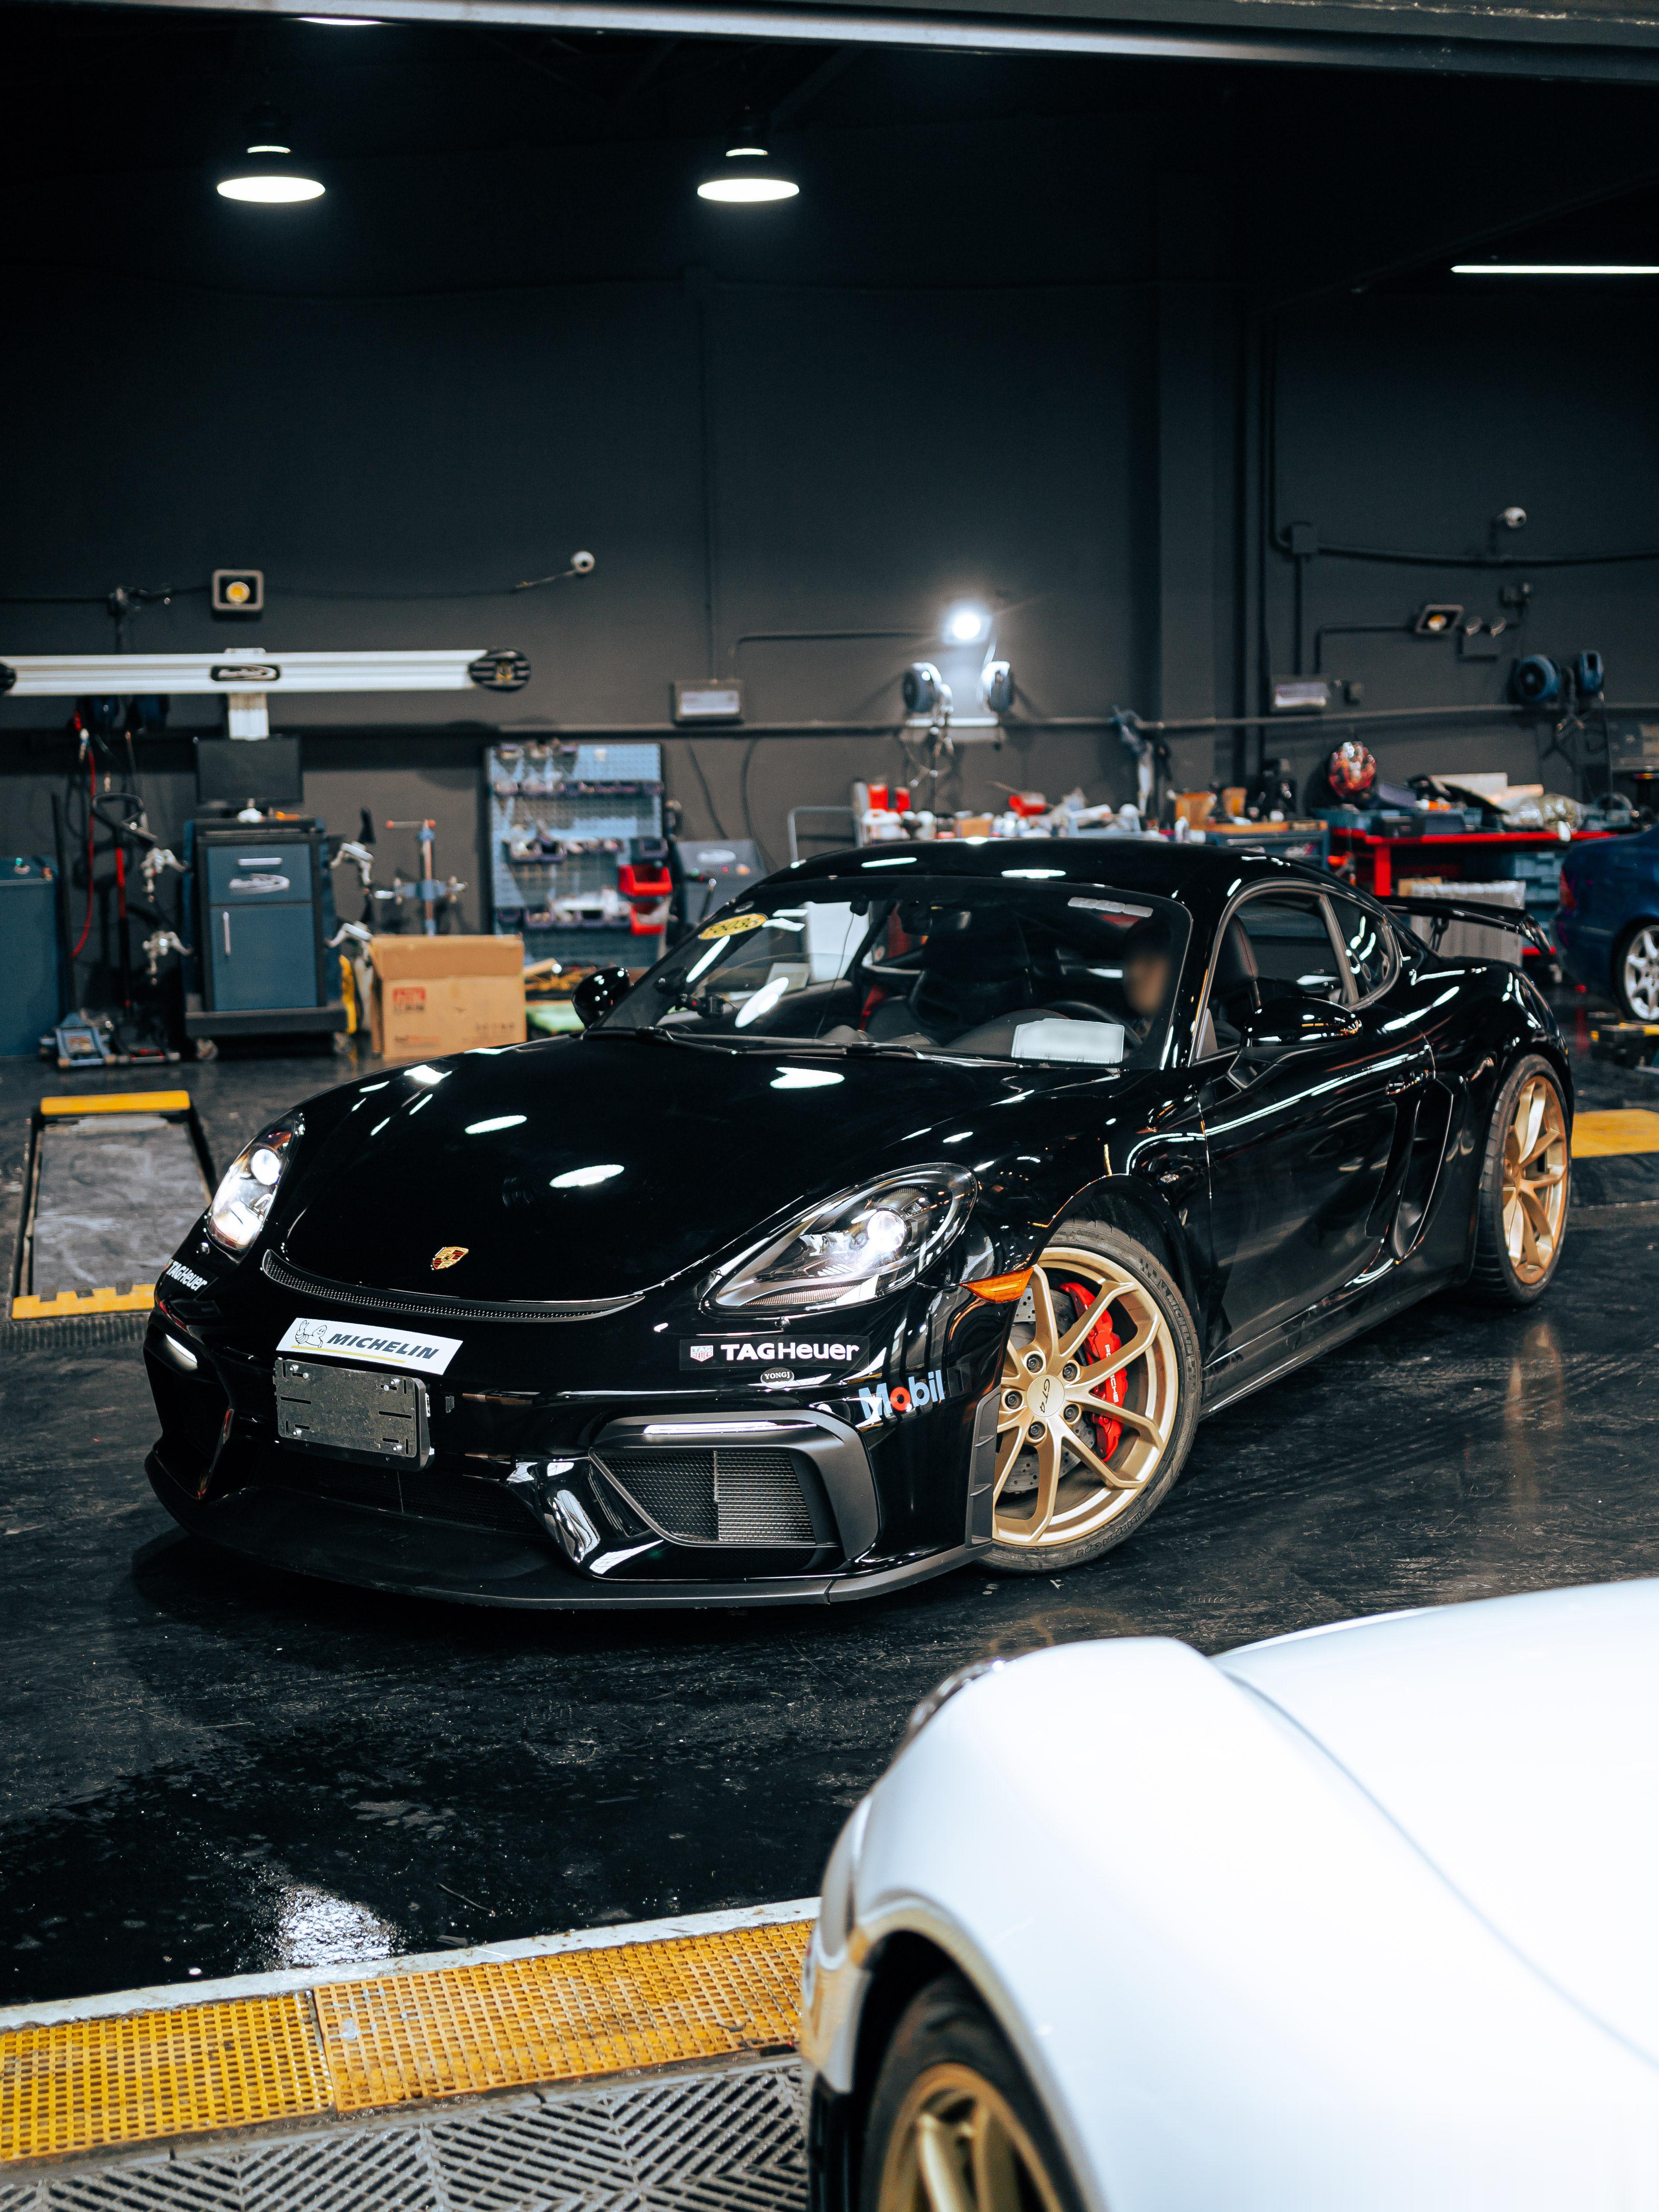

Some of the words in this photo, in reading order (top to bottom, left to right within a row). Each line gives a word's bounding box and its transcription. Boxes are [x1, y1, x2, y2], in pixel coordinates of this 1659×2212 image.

[327, 1333, 440, 1359] MICHELIN
[1166, 1294, 1194, 1355] MICHELIN
[859, 1369, 945, 1419] Mobil
[1040, 1378, 1050, 1413] GT4
[1105, 1344, 1119, 1403] PCHE
